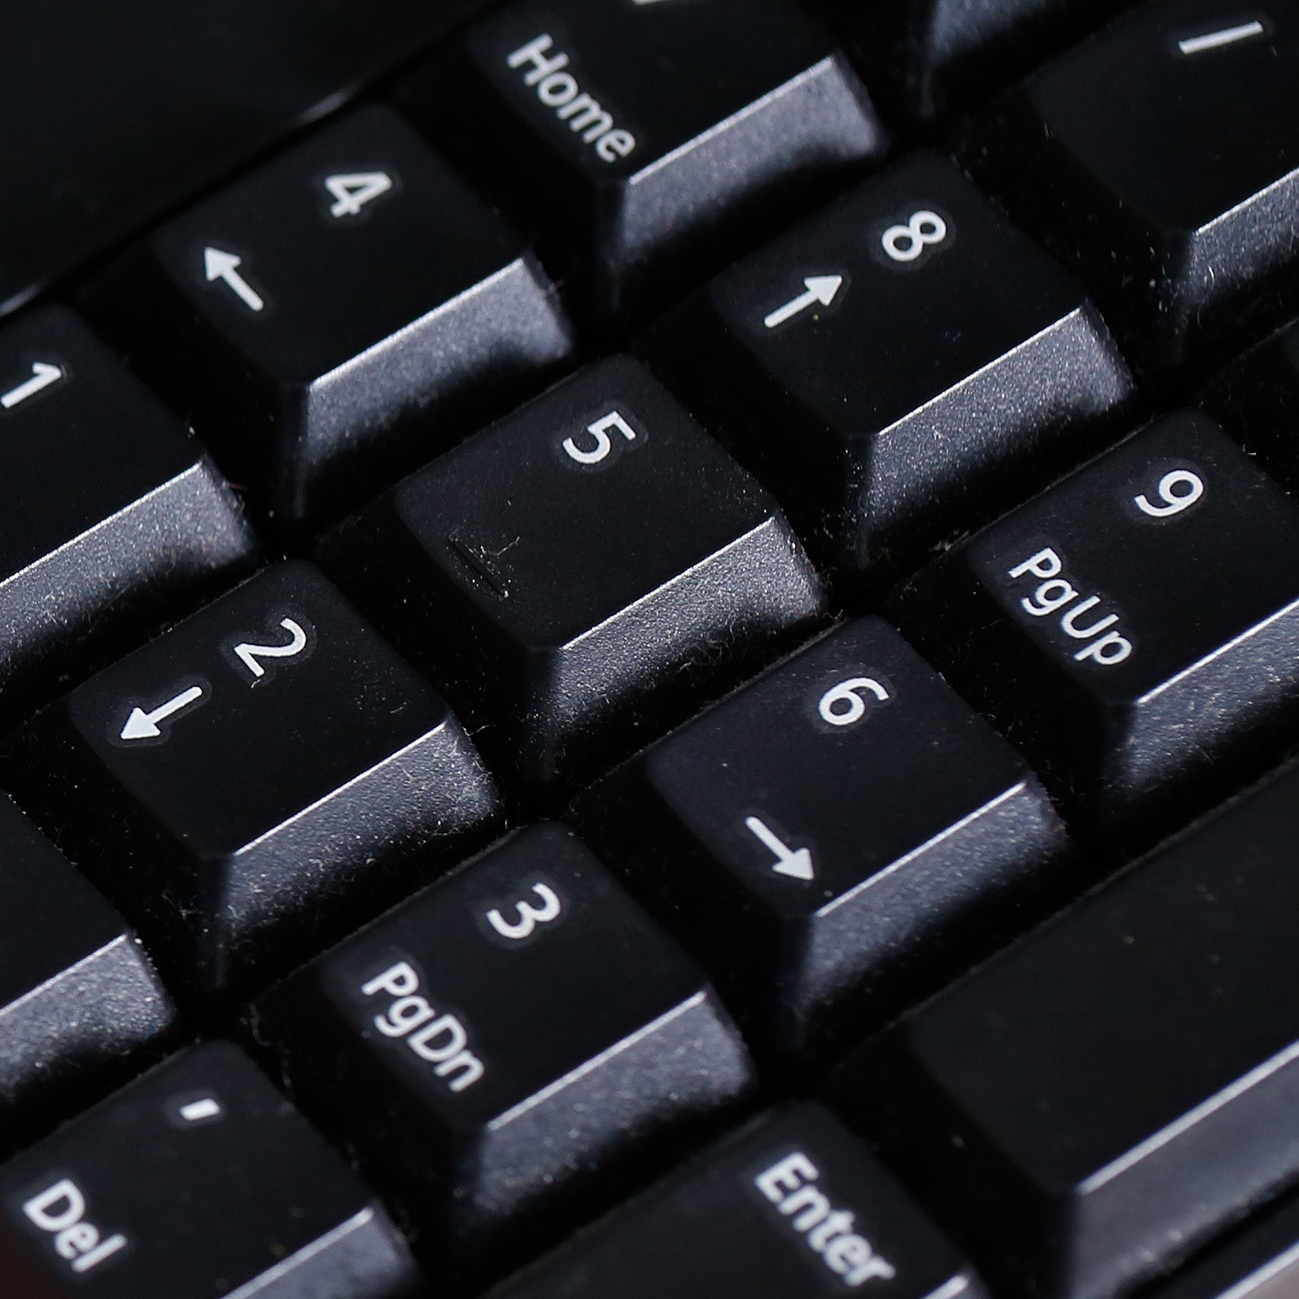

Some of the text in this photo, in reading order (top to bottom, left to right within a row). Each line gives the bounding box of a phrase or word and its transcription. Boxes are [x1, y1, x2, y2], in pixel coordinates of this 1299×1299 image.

[507, 33, 637, 163] Home
[324, 171, 393, 219] 4
[880, 209, 948, 263] 8
[0, 361, 63, 409] 1
[562, 410, 637, 464] 5
[1134, 468, 1205, 519] 9
[1007, 546, 1134, 666] PgUp
[233, 616, 308, 678] 2
[817, 676, 891, 727] 6
[486, 881, 562, 940] 3
[360, 960, 485, 1093] PgDn
[22, 1178, 127, 1273] Del
[754, 1151, 896, 1287] Enter
